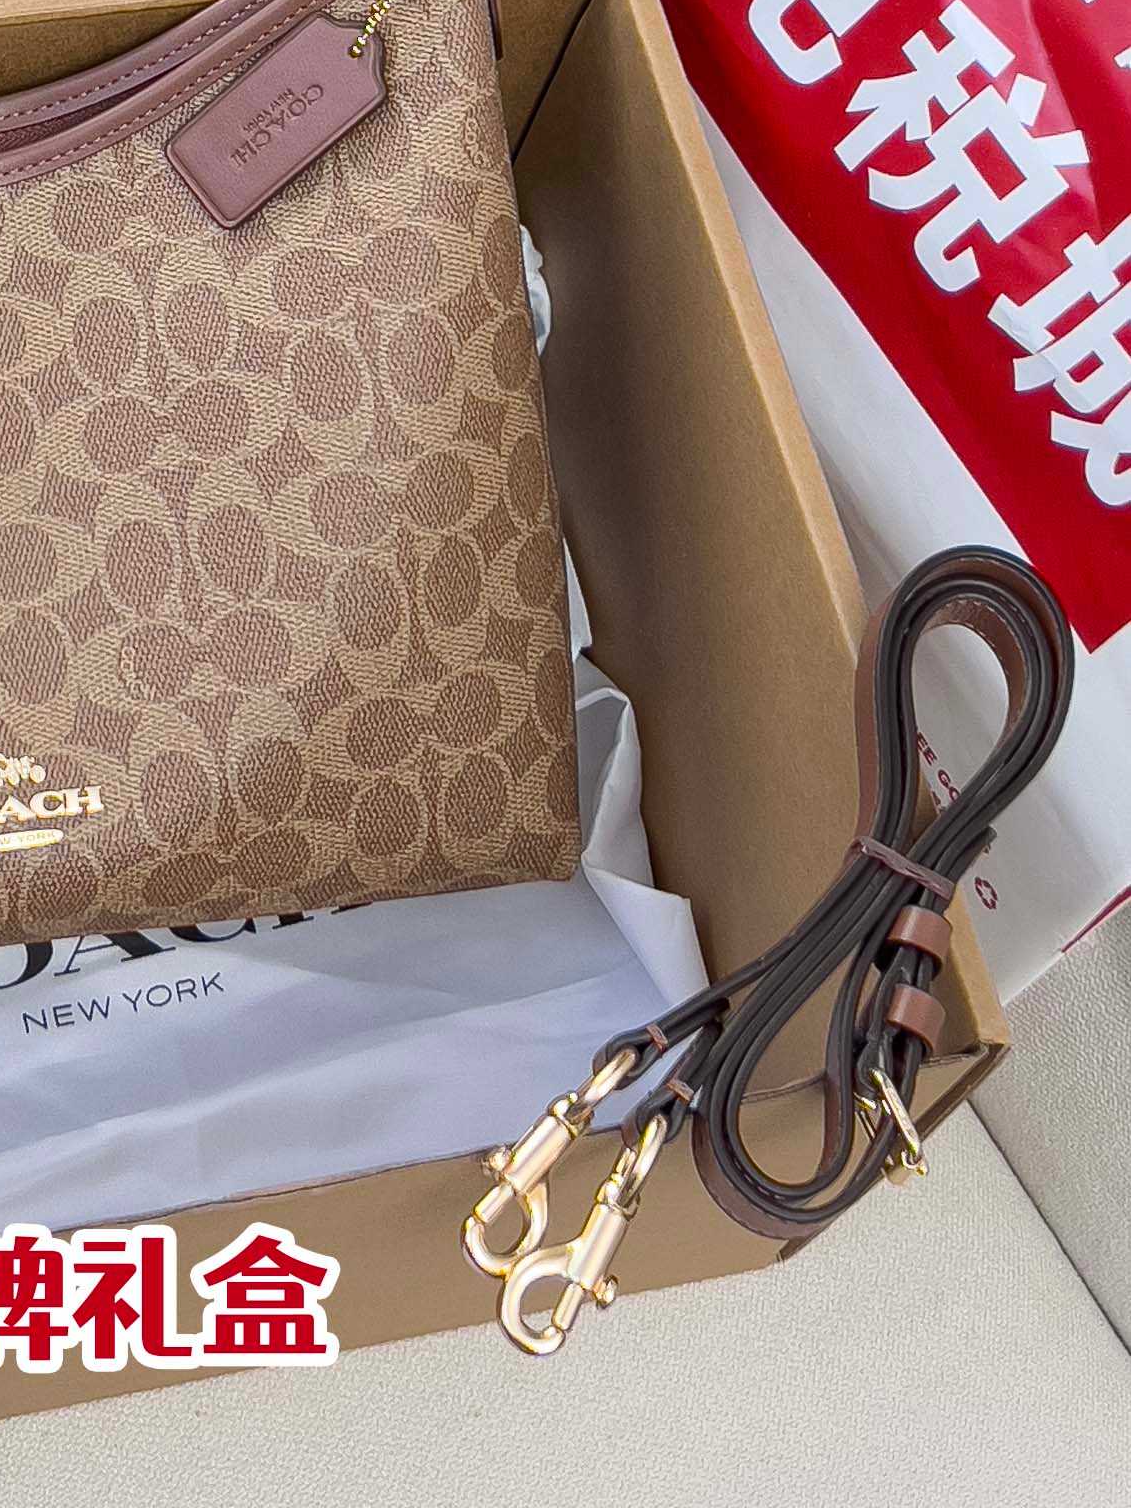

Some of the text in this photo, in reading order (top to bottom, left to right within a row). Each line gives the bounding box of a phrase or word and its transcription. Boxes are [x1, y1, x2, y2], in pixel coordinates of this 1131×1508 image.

[230, 84, 324, 169] COACH
[22, 972, 225, 1035] NEW YORK
